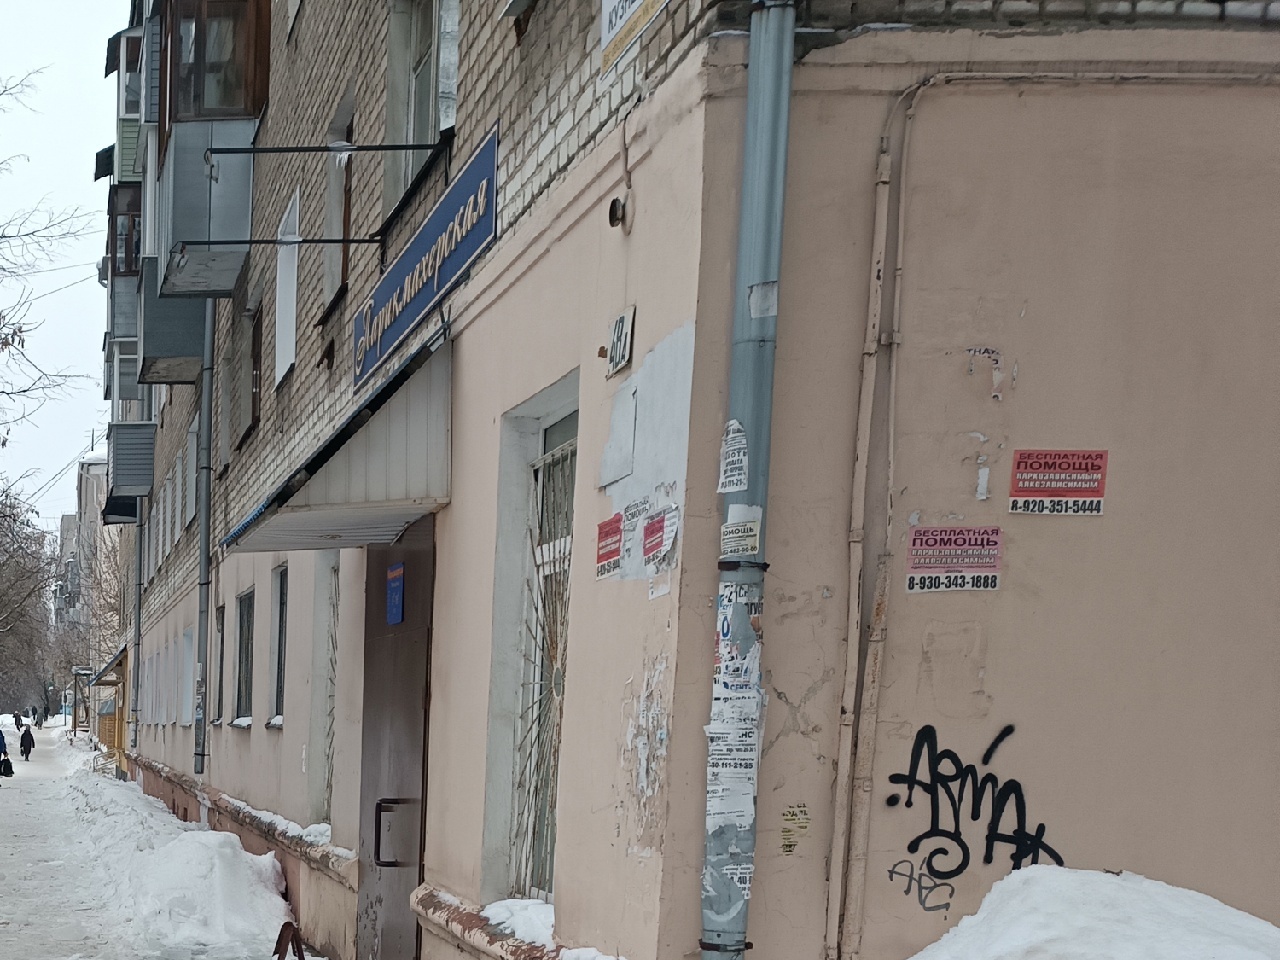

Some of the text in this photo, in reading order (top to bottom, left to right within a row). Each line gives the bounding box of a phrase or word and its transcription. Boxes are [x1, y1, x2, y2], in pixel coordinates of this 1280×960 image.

[355, 177, 488, 376] Парикмахерская
[1016, 461, 1102, 472] ПОМОЩЬ
[1011, 499, 1101, 513] 8-920-351-5444
[723, 526, 753, 536] ОМОЩЬ
[914, 529, 999, 537] БЕСПЛАТНАЯ
[912, 537, 998, 548] ПОМОЩЬ
[908, 575, 997, 590] 8-930-343-1888
